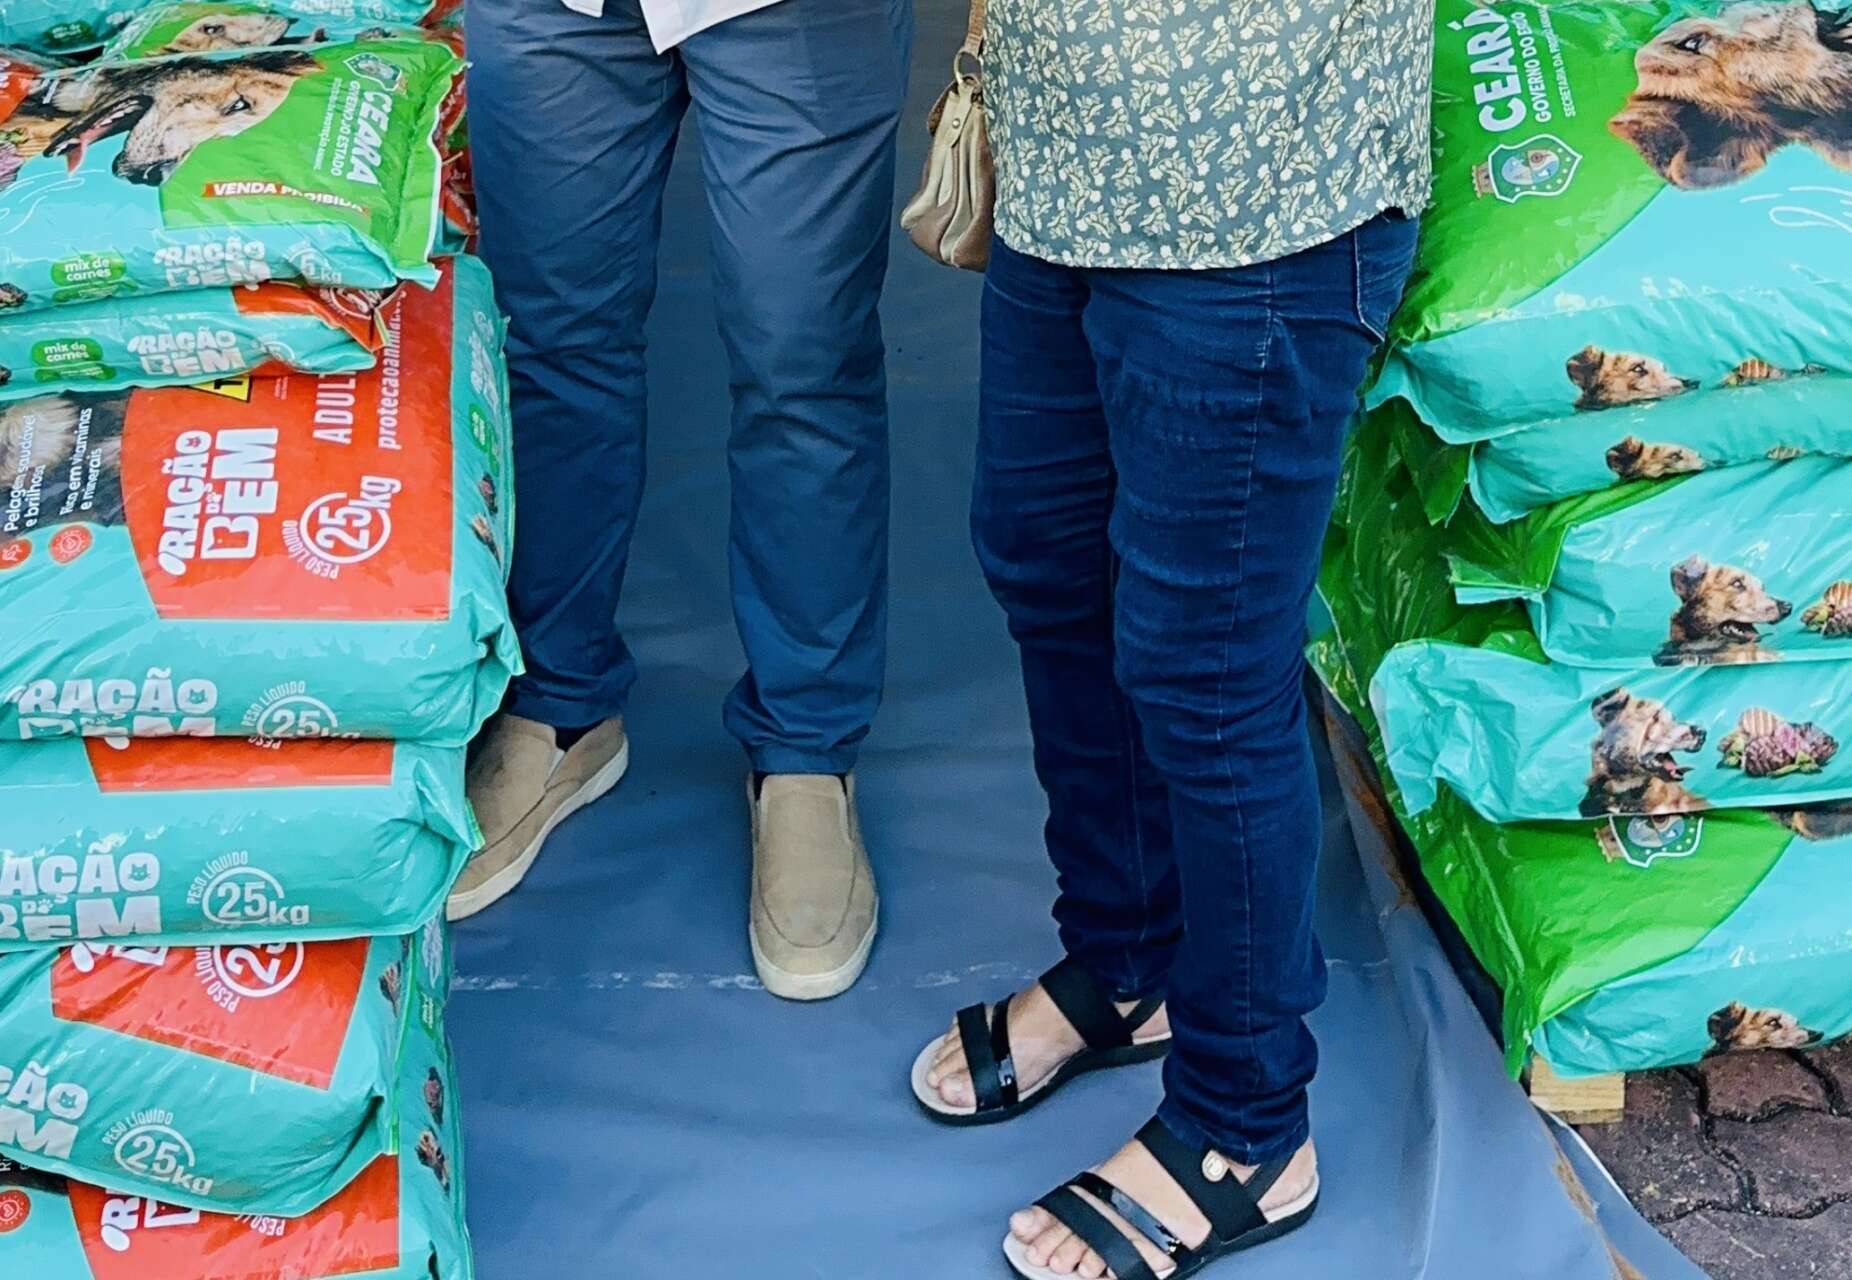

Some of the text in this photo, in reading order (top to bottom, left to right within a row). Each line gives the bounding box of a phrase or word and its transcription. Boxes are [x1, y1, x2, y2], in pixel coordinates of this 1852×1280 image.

[1519, 36, 1538, 59] DO
[1552, 52, 1564, 67] DA
[1446, 8, 1527, 132] CEARÁ
[1523, 58, 1552, 123] GOVERNO
[331, 134, 349, 176] ESTADO
[213, 182, 278, 196] VENDA
[64, 256, 110, 273] mix de
[153, 237, 265, 266] RAÇÃO
[66, 268, 111, 282] carnes
[44, 341, 87, 355] mix de
[46, 351, 89, 363] carnes
[127, 326, 236, 354] RAÇÃO
[139, 348, 247, 378] BEM
[312, 372, 357, 446] ADUL
[23, 464, 47, 528] e brilhosa
[69, 465, 83, 491] em
[80, 447, 103, 511] e minerais
[200, 427, 280, 560] BEM
[4, 475, 27, 532] Pelagem
[157, 430, 213, 577] RAÇÃO
[281, 519, 341, 580] PESO LÍQUIDO
[3, 667, 218, 720] RAÇÃO
[260, 679, 307, 707] LÍQUIDO
[186, 850, 249, 905] PESO LÍQUIDO
[216, 881, 310, 926] 25kg
[207, 981, 241, 1014] PESO
[101, 1108, 174, 1146] PESO LÍQUIDO
[126, 1135, 214, 1196] 25kg
